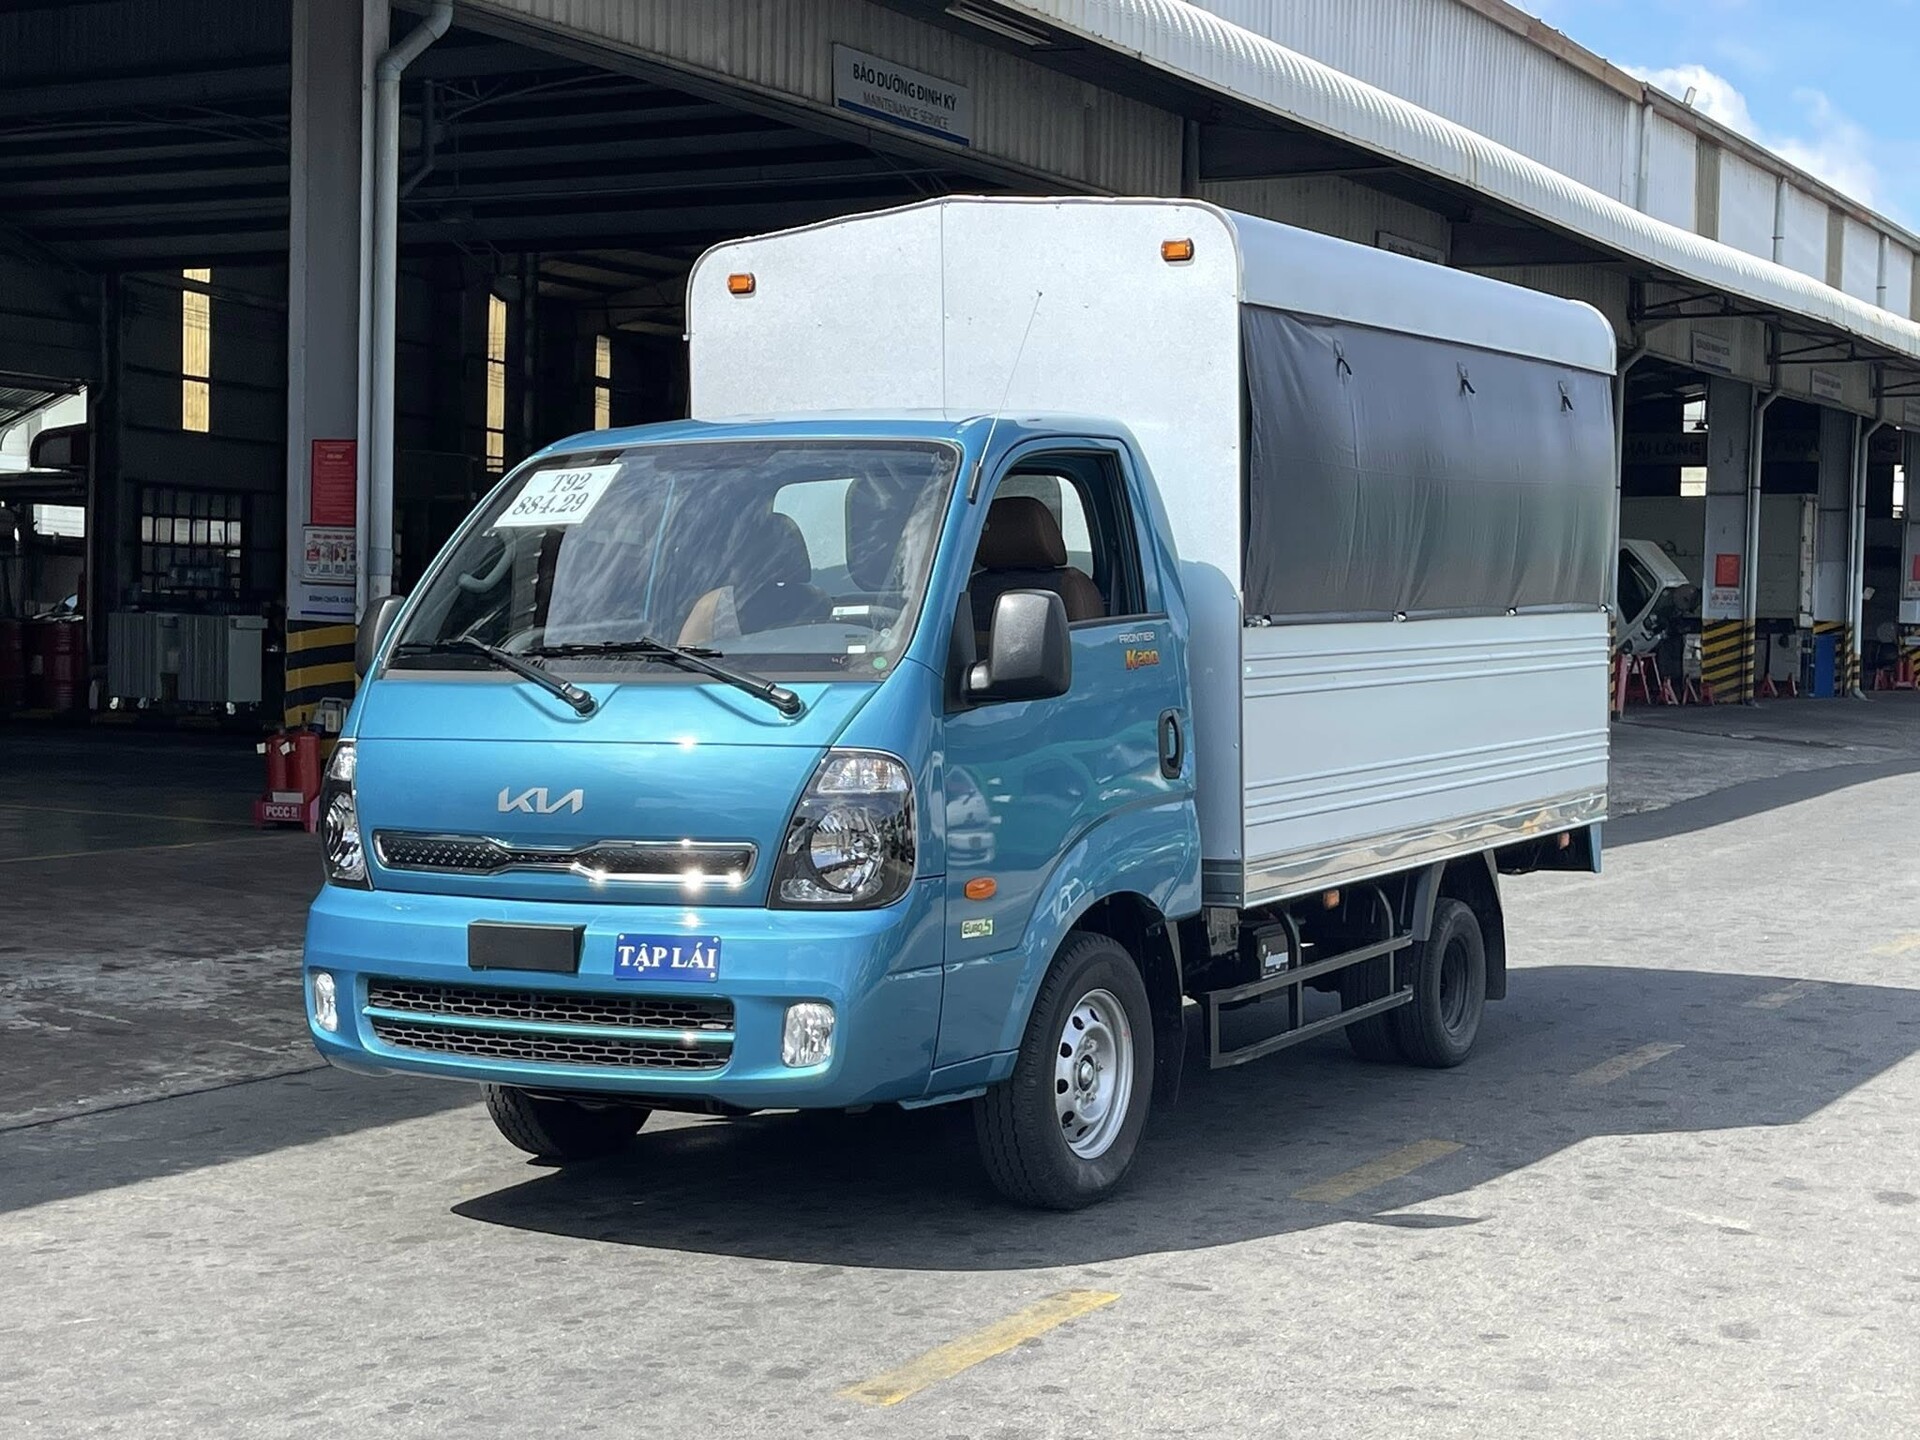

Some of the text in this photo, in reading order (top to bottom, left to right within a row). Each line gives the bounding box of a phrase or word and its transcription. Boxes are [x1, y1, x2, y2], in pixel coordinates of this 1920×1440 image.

[853, 62, 957, 112] BẢO DƯỠNG ĐỊNH KỲ
[863, 92, 949, 130] MAINTENANCE SERVICE
[548, 472, 592, 494] T92
[513, 493, 589, 515] 884.29
[1119, 631, 1155, 644] FRONTIER
[1126, 649, 1159, 670] K200
[265, 805, 290, 818] PCCC
[498, 786, 584, 815] KIA
[617, 942, 718, 972] TẬP LÁI
